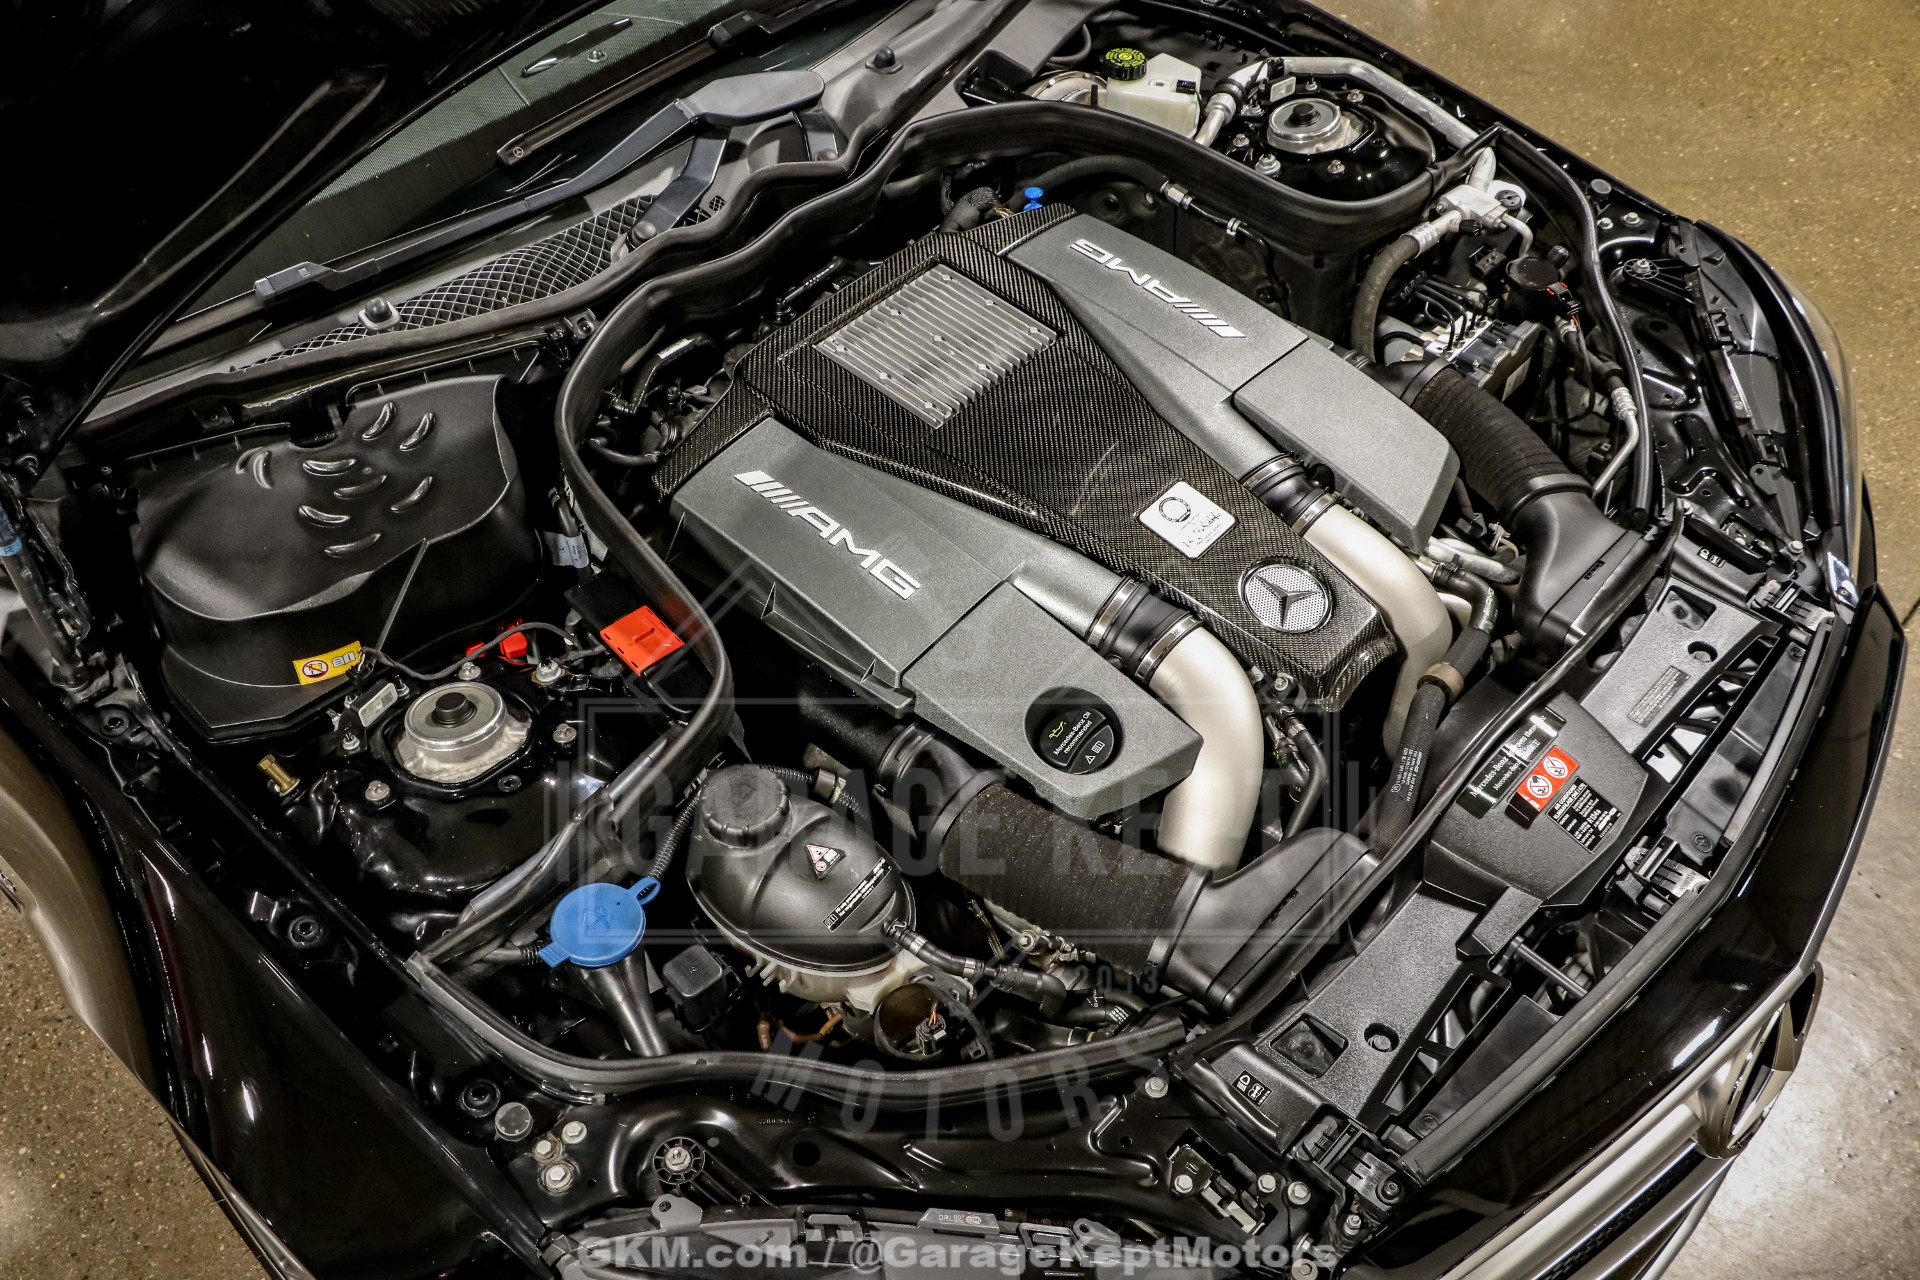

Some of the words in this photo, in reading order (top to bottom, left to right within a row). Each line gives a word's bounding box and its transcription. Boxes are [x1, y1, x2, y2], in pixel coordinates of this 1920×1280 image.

[1070, 238, 1192, 304] AMG
[786, 506, 921, 600] AMG
[1053, 718, 1086, 756] Mercedes-Benz
[1063, 720, 1093, 754] recommended
